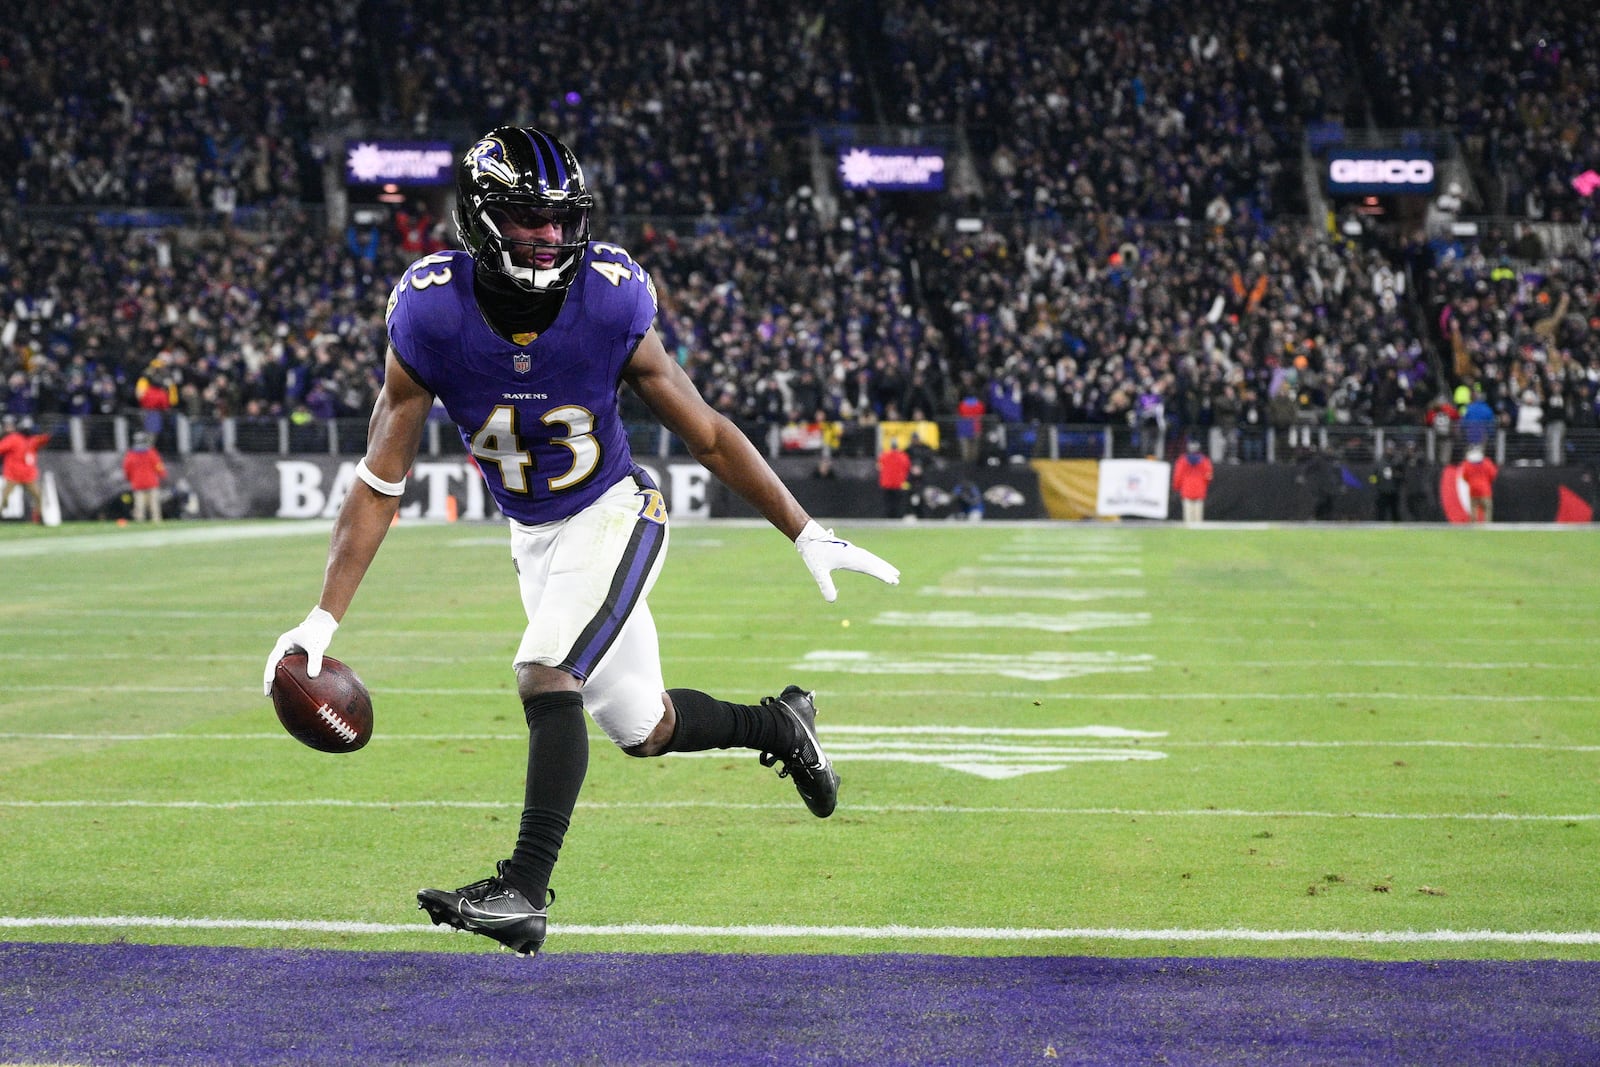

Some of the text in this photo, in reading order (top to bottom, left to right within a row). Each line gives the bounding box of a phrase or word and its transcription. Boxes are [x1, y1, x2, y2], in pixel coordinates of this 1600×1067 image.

[1330, 159, 1435, 184] GEICO
[590, 243, 633, 287] 43
[502, 392, 548, 400] RAVENS
[470, 404, 602, 494] 43
